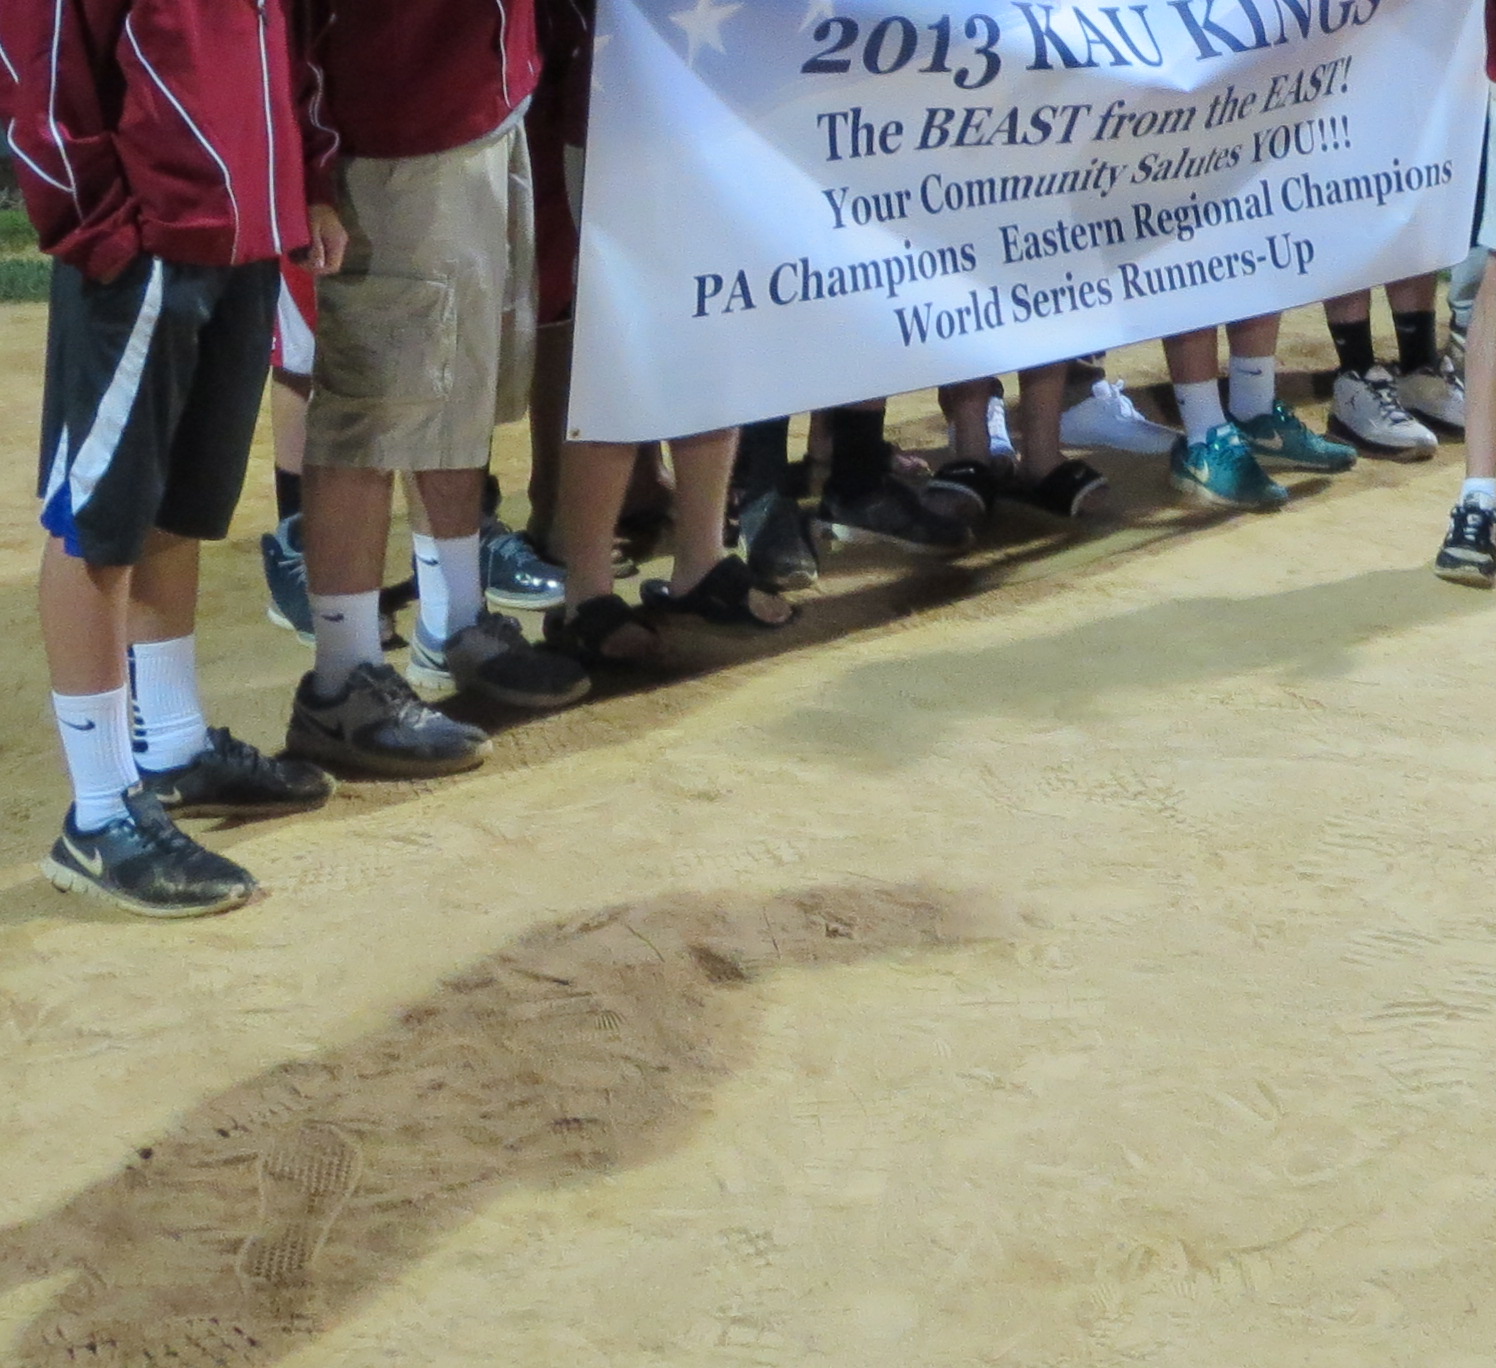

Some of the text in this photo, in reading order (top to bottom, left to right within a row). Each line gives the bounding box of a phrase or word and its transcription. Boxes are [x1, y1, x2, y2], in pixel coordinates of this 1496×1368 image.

[801, 13, 1002, 90] 2013
[1012, 0, 1165, 70] KAU
[817, 55, 1353, 162] The BEAST from the EAST!
[822, 115, 1353, 230] Your Community Salutes YOU!!!
[691, 157, 1454, 318] PA Champions Eastern Regional Champions
[894, 232, 1315, 348] World Series Runners-Up
